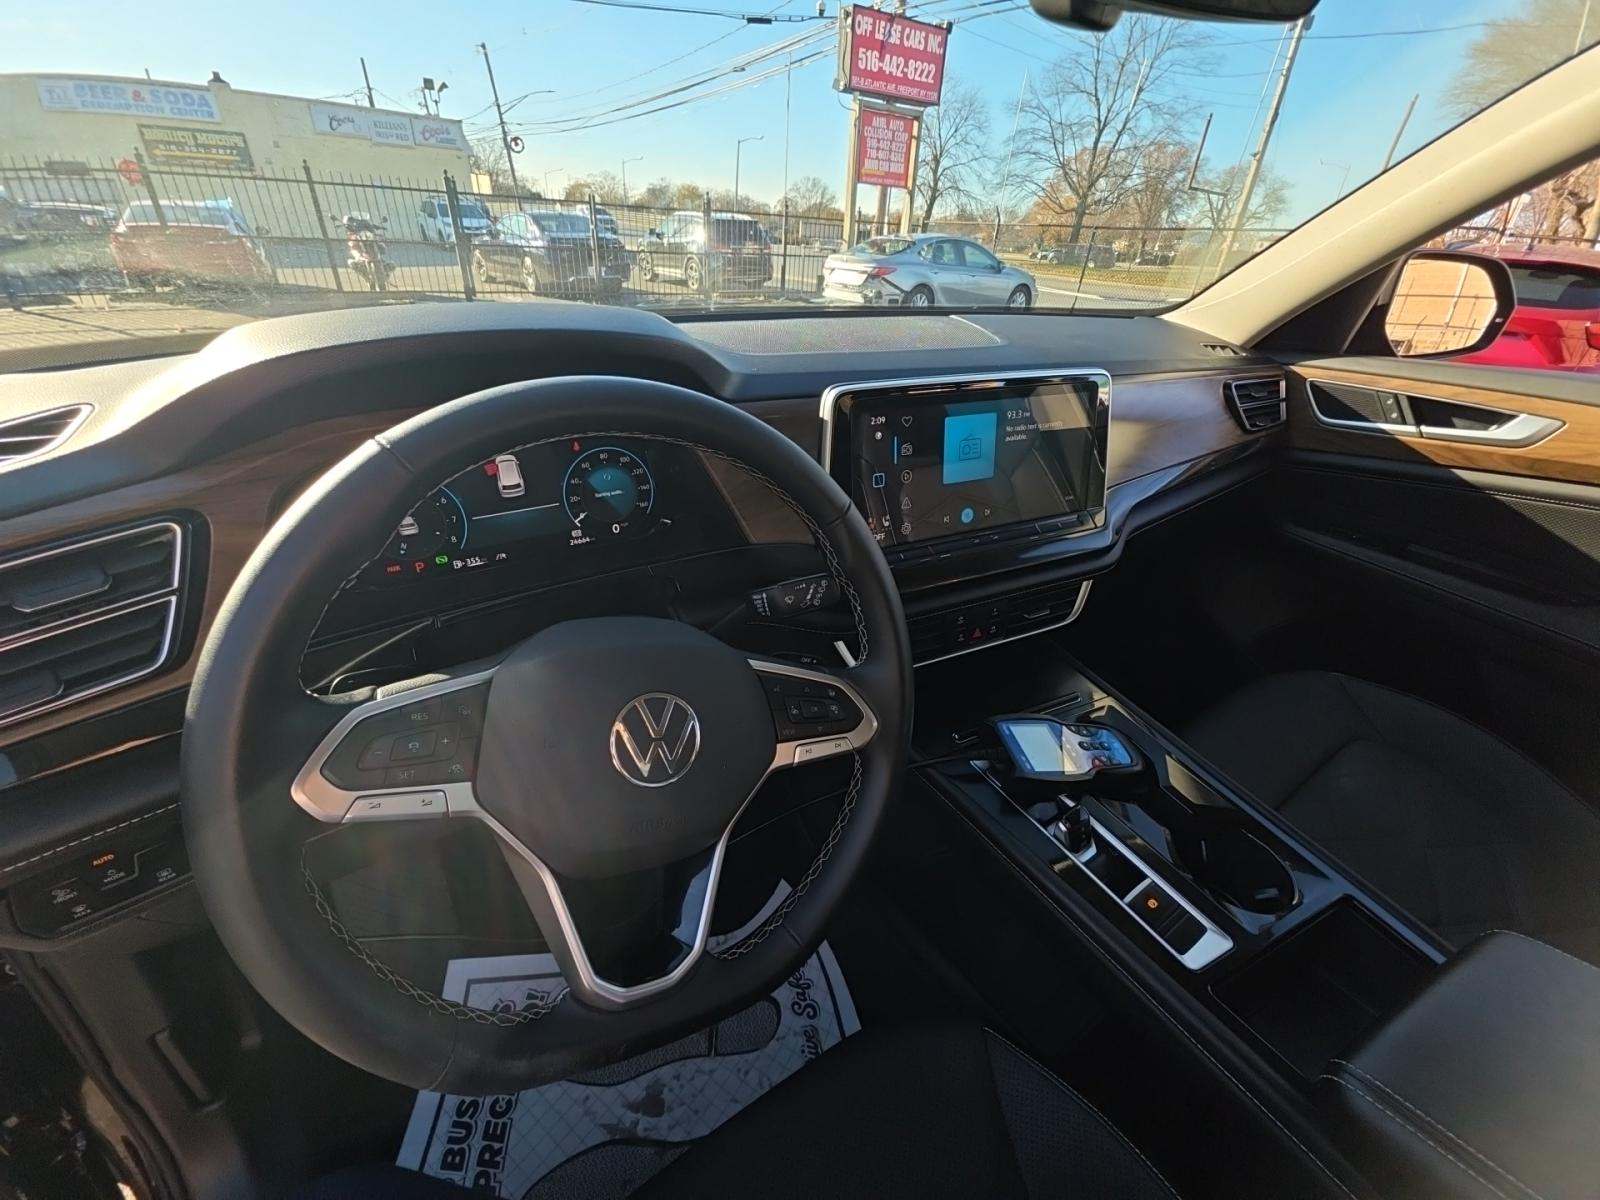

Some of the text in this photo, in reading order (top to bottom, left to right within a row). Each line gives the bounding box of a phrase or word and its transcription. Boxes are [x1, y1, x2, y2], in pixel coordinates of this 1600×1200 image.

[855, 14, 873, 37] OFF
[903, 28, 925, 51] CARS
[927, 34, 943, 55] INC.
[858, 47, 936, 84] 516-442-8222
[73, 82, 127, 100] BEER
[131, 88, 146, 103] &
[149, 88, 213, 110] SODA
[169, 107, 215, 120] CENTER
[889, 119, 905, 132] AUTO
[395, 133, 410, 142] RED
[864, 126, 893, 140] COLLISION
[870, 415, 886, 426] 2:09
[1007, 410, 1022, 420] 93.3
[620, 455, 630, 463] 100
[612, 523, 620, 534] 0
[415, 562, 424, 574] P
[411, 711, 429, 721] RES
[399, 769, 416, 780] SET
[92, 853, 115, 867] AUTO
